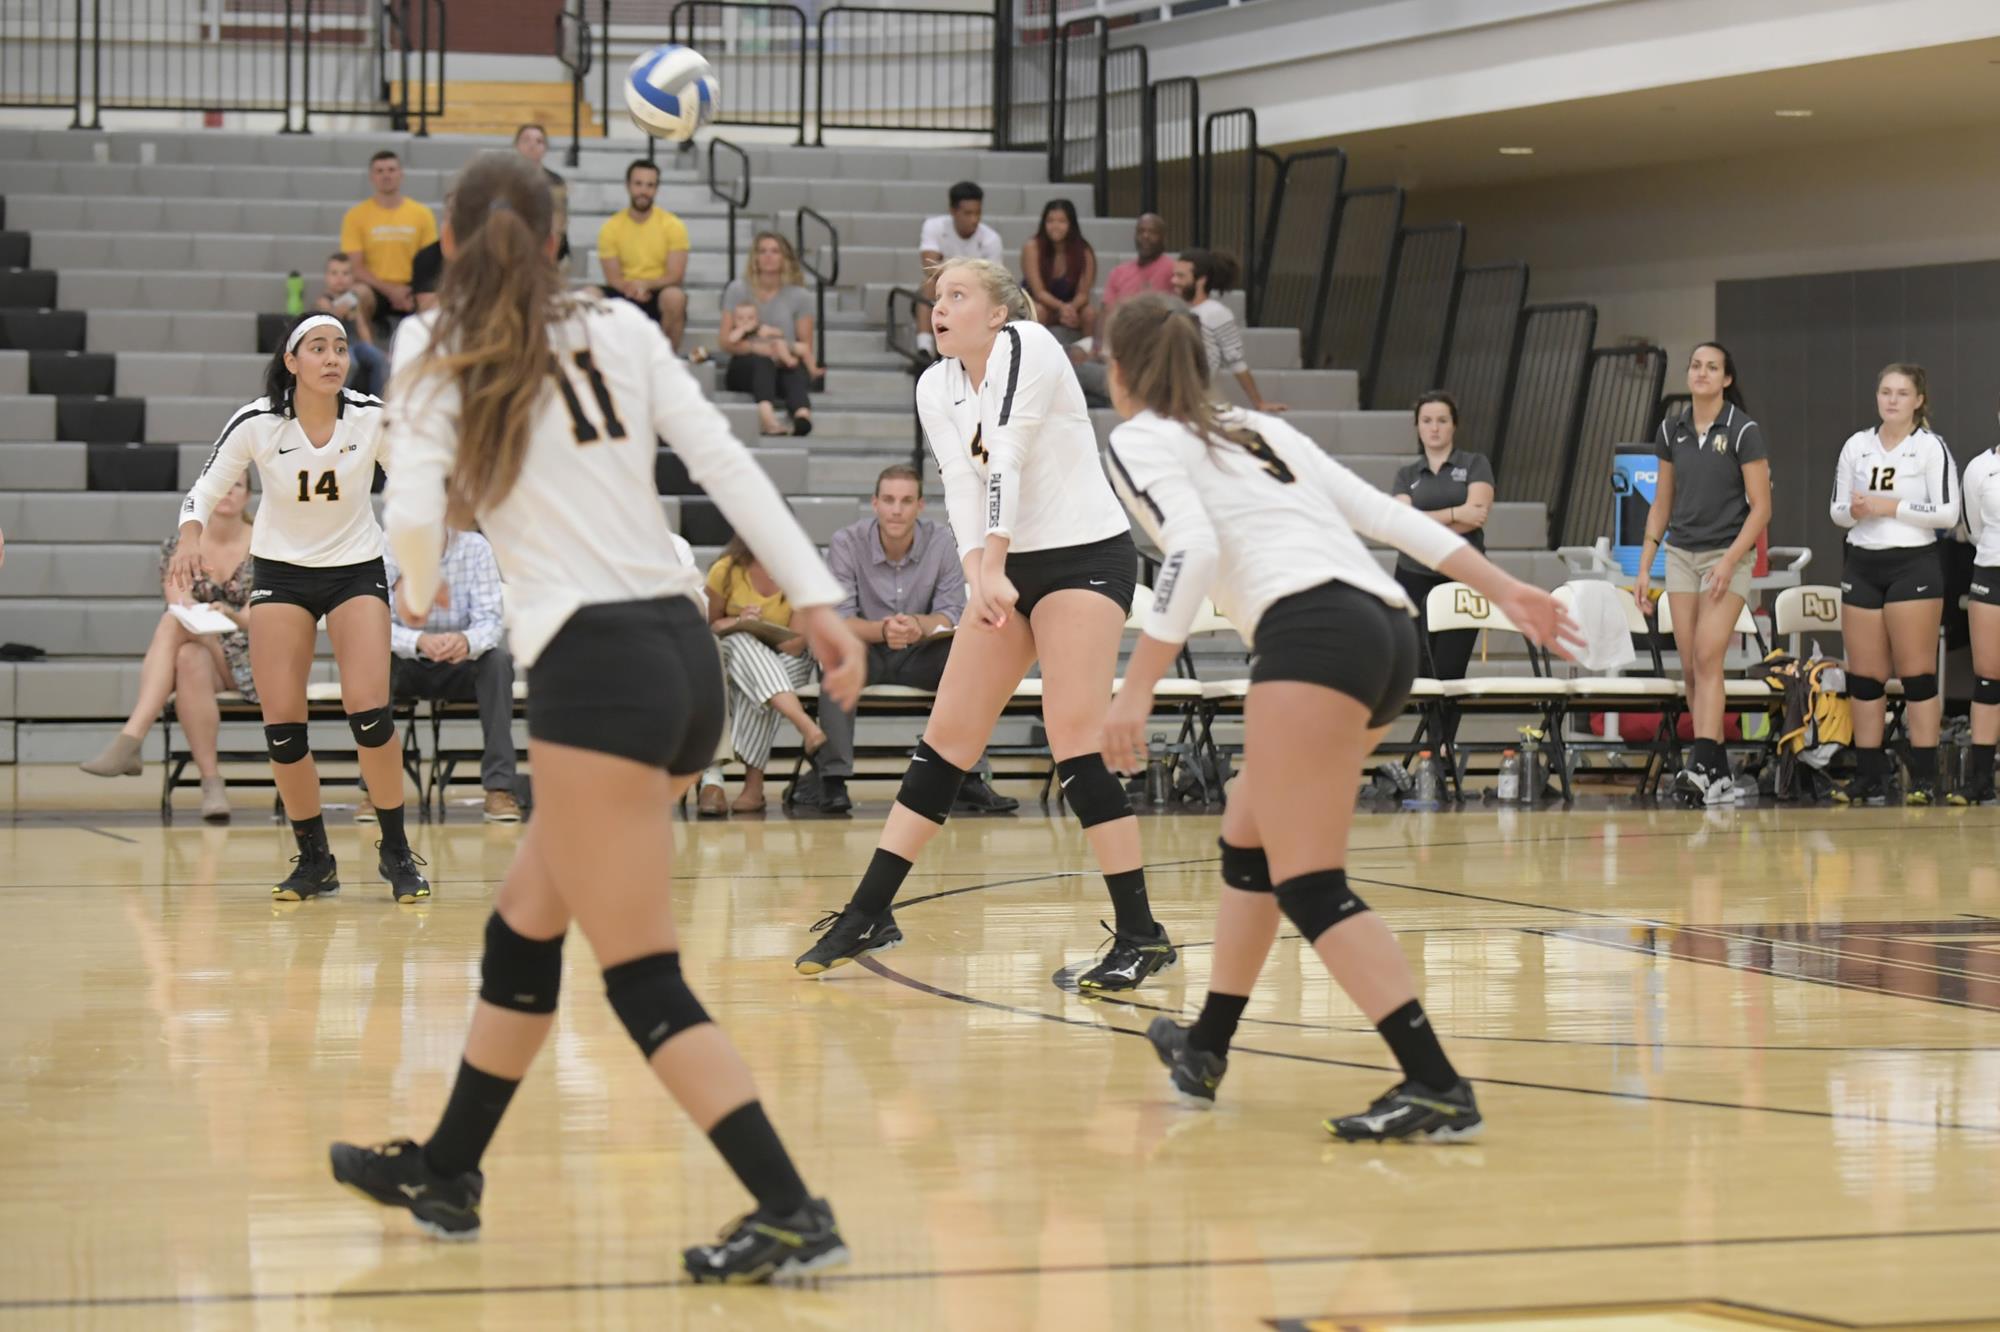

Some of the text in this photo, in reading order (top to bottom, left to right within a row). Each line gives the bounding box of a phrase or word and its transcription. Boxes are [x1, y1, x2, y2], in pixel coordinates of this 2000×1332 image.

[549, 349, 628, 444] 11
[297, 469, 340, 502] 14
[1868, 466, 1896, 491] 12
[989, 473, 1002, 528] PANTHERS
[1455, 589, 1490, 619] AU
[1802, 592, 1837, 621] AU
